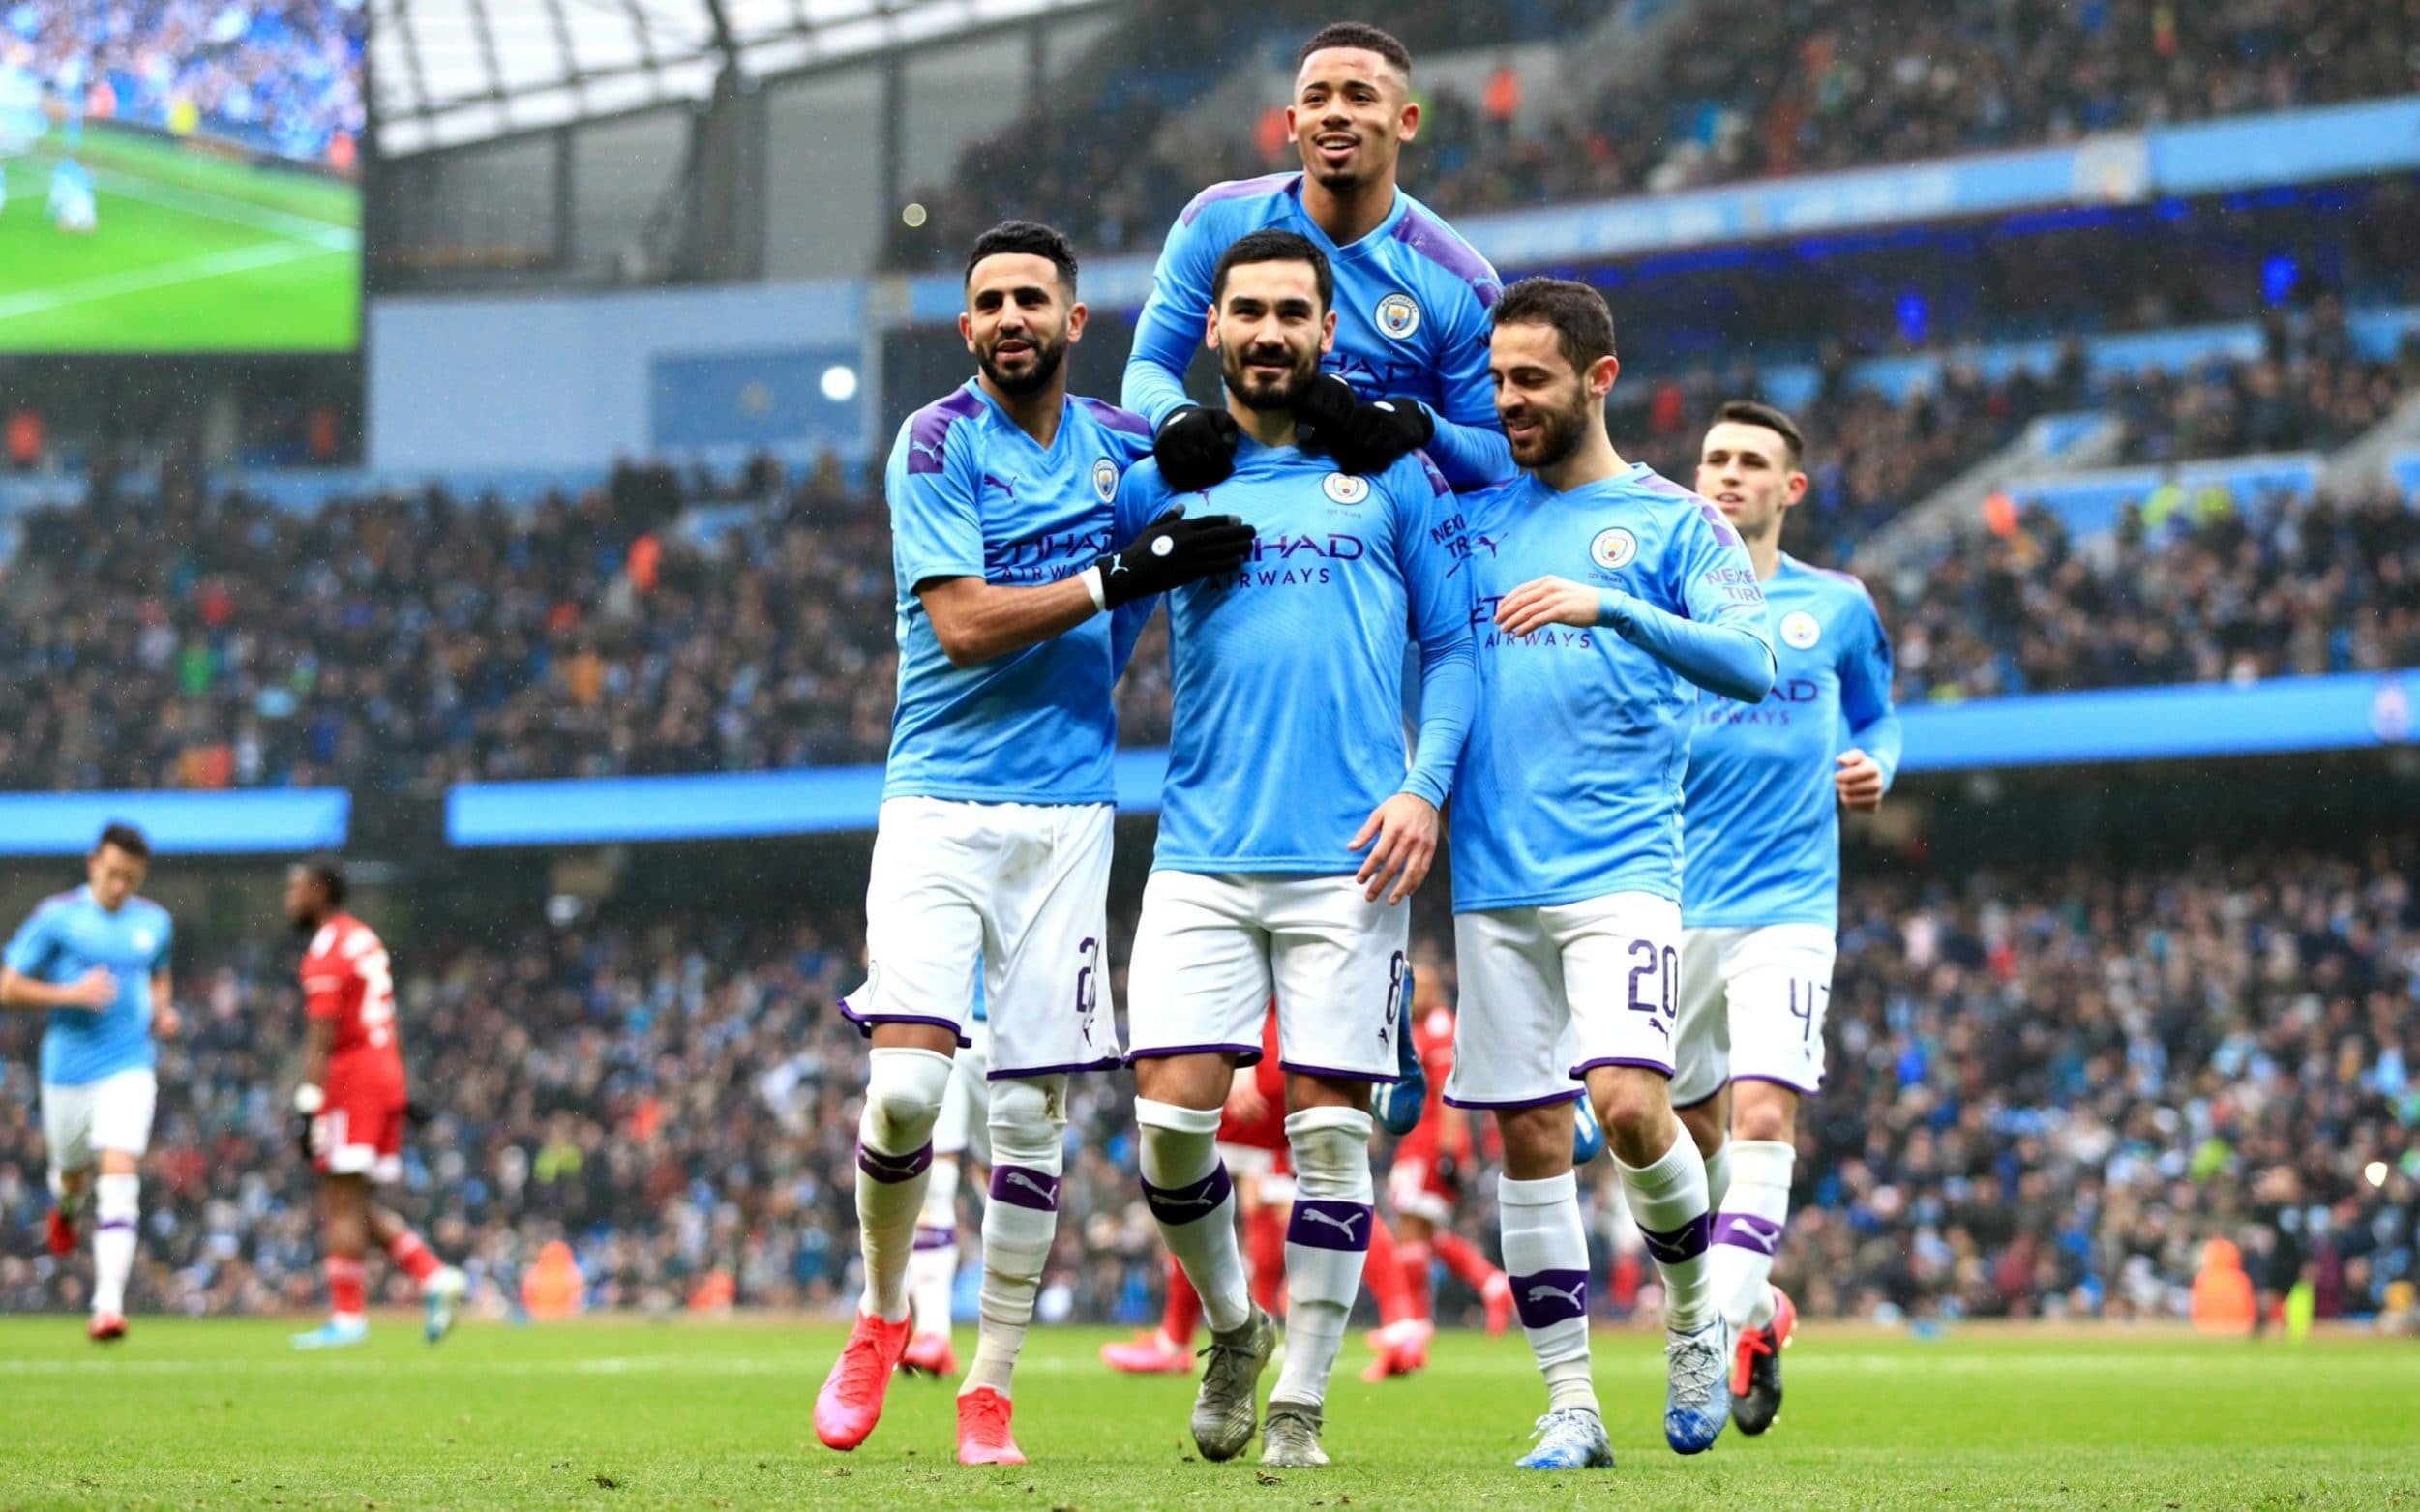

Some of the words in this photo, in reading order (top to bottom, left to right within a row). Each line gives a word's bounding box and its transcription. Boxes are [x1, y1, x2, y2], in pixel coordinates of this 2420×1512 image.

[1704, 567, 1756, 585] NEXE
[1484, 632, 1592, 650] AIRWAYS
[1699, 709, 1791, 726] IRWAYS
[1386, 949, 1405, 1025] 8
[1628, 938, 1679, 1020] 20
